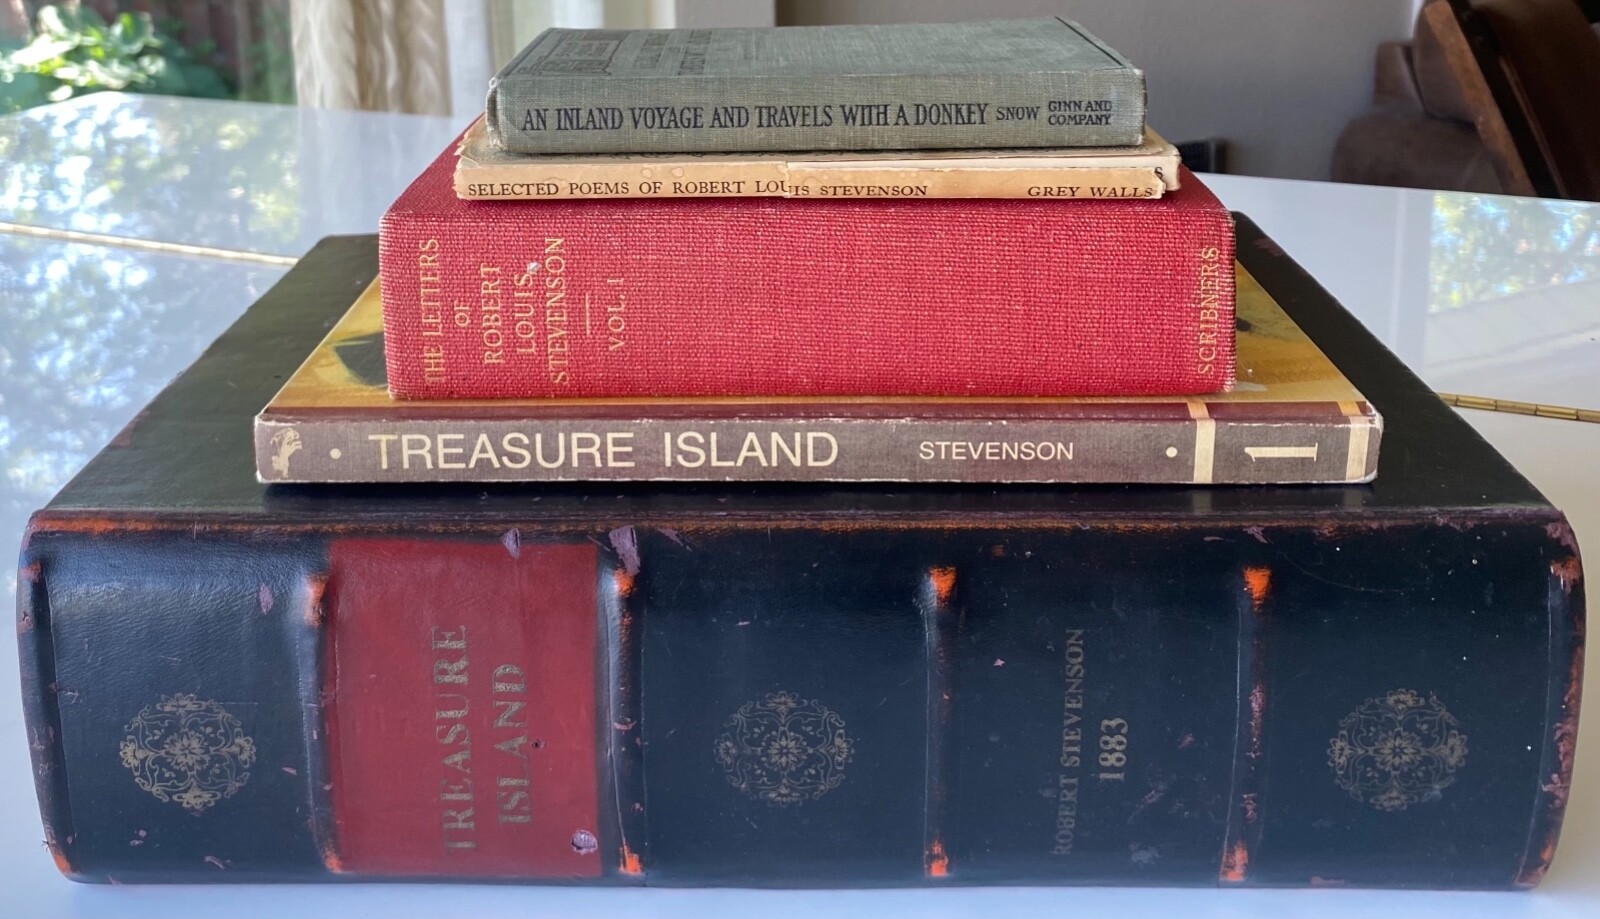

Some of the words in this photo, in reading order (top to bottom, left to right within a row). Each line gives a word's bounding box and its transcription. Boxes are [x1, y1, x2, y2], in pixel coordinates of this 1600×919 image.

[522, 108, 549, 131] AN
[556, 108, 624, 130] INLAND
[630, 107, 704, 129] VOYAGE
[709, 106, 749, 128] AND
[755, 105, 833, 128] TRAVELS
[840, 104, 891, 127] WITH
[893, 104, 909, 126] A
[914, 103, 989, 126] DONKEY
[996, 106, 1040, 120] SNOW
[1048, 101, 1082, 112] GINN
[1085, 101, 1113, 112] AND
[1048, 114, 1113, 126] COMPANY
[468, 183, 559, 196] SELECTED
[569, 182, 630, 195] POEMS
[638, 182, 663, 194] OF
[673, 181, 746, 194] ROBERT
[755, 181, 810, 196] LOUIS
[820, 185, 928, 197] STEVENSON
[1028, 186, 1080, 197] GREY
[1089, 187, 1154, 198] WALLS
[418, 239, 444, 337] LETTERS
[454, 299, 471, 327] OF
[480, 263, 505, 365] ROBERT
[545, 237, 569, 385] STEVENSON
[1197, 247, 1219, 375] SCRIBNERS
[424, 344, 445, 384] THE
[368, 431, 635, 469] TREASURE
[664, 430, 838, 469] ISLAND
[919, 440, 1074, 461] STEVENSON
[1243, 442, 1318, 463] 1
[1060, 628, 1085, 768] STEVENSON
[431, 624, 477, 851] TREASURE
[493, 664, 532, 824] ISLAND
[1098, 717, 1128, 783] 1883
[1052, 774, 1078, 855] ROBERT
